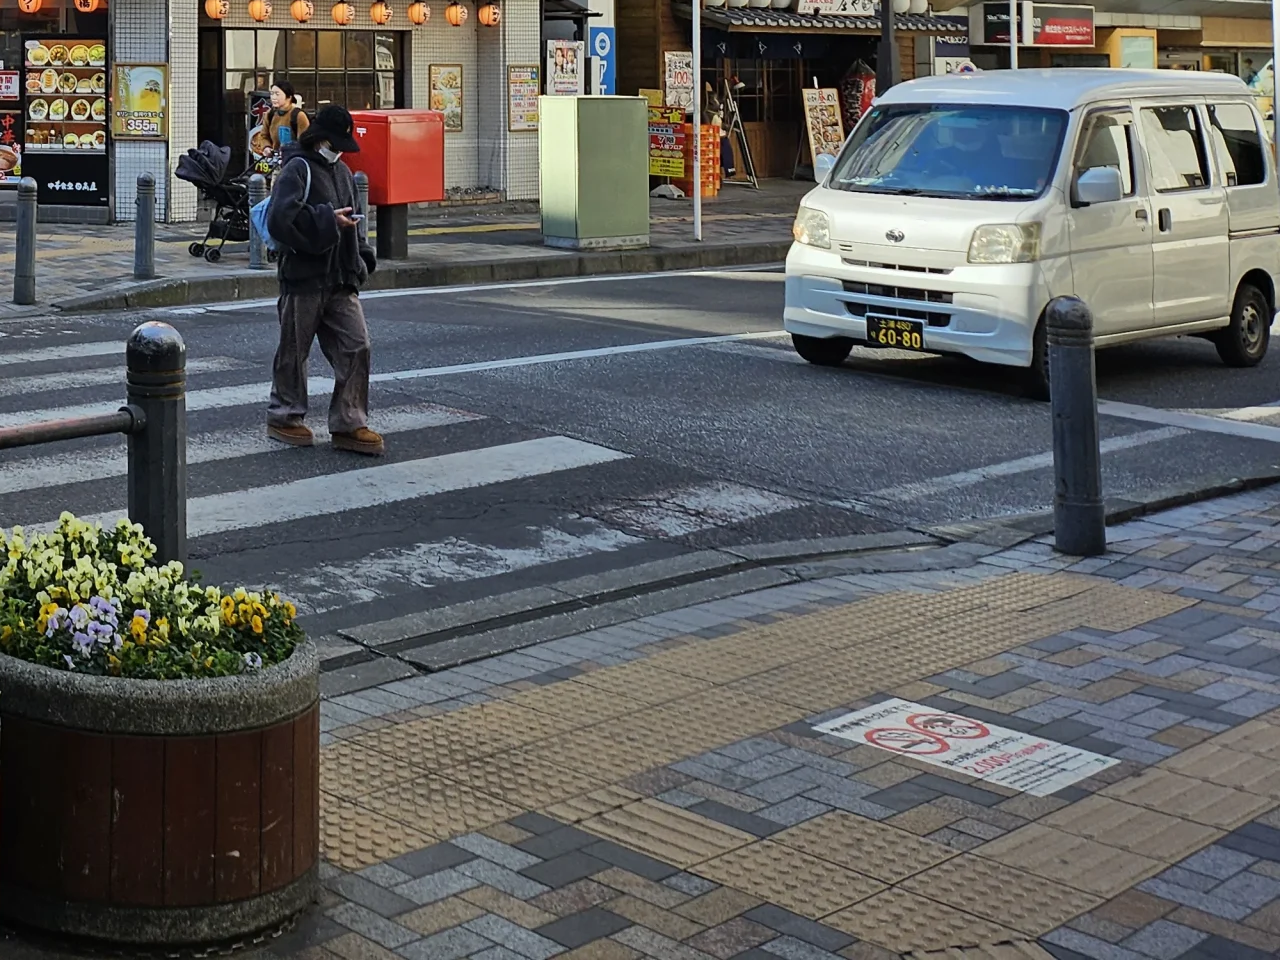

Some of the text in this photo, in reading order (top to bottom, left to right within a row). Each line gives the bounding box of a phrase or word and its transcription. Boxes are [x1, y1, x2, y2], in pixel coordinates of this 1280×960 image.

[1, 114, 15, 144] 中華
[127, 119, 158, 131] 355円
[878, 328, 921, 348] 60-80
